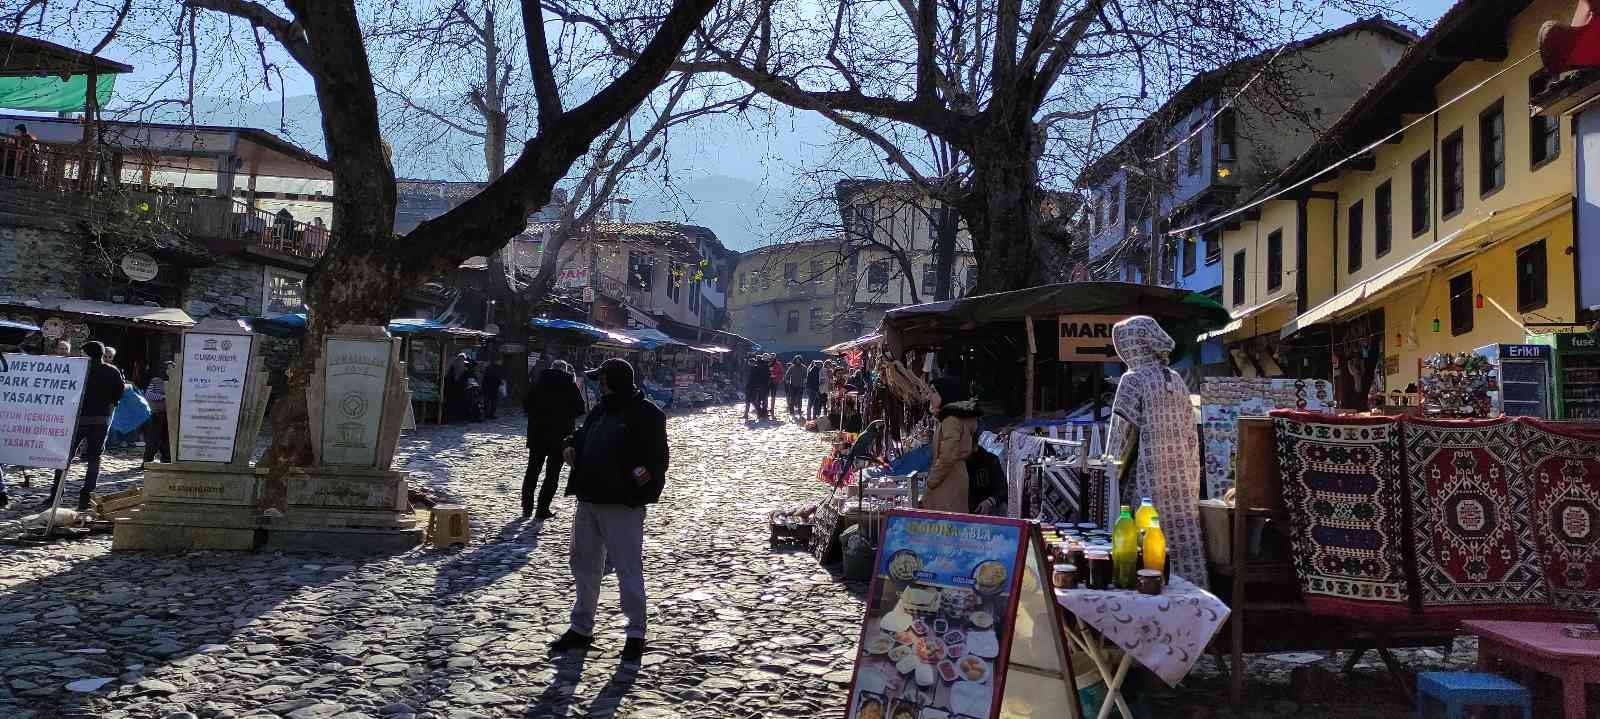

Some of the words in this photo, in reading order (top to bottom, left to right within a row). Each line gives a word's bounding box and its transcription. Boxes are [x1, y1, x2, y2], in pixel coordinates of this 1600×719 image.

[1571, 337, 1596, 347] fuse
[10, 360, 71, 375] MEYDANA
[33, 377, 78, 391] ETMEK
[2, 391, 65, 406] YASAKTIR
